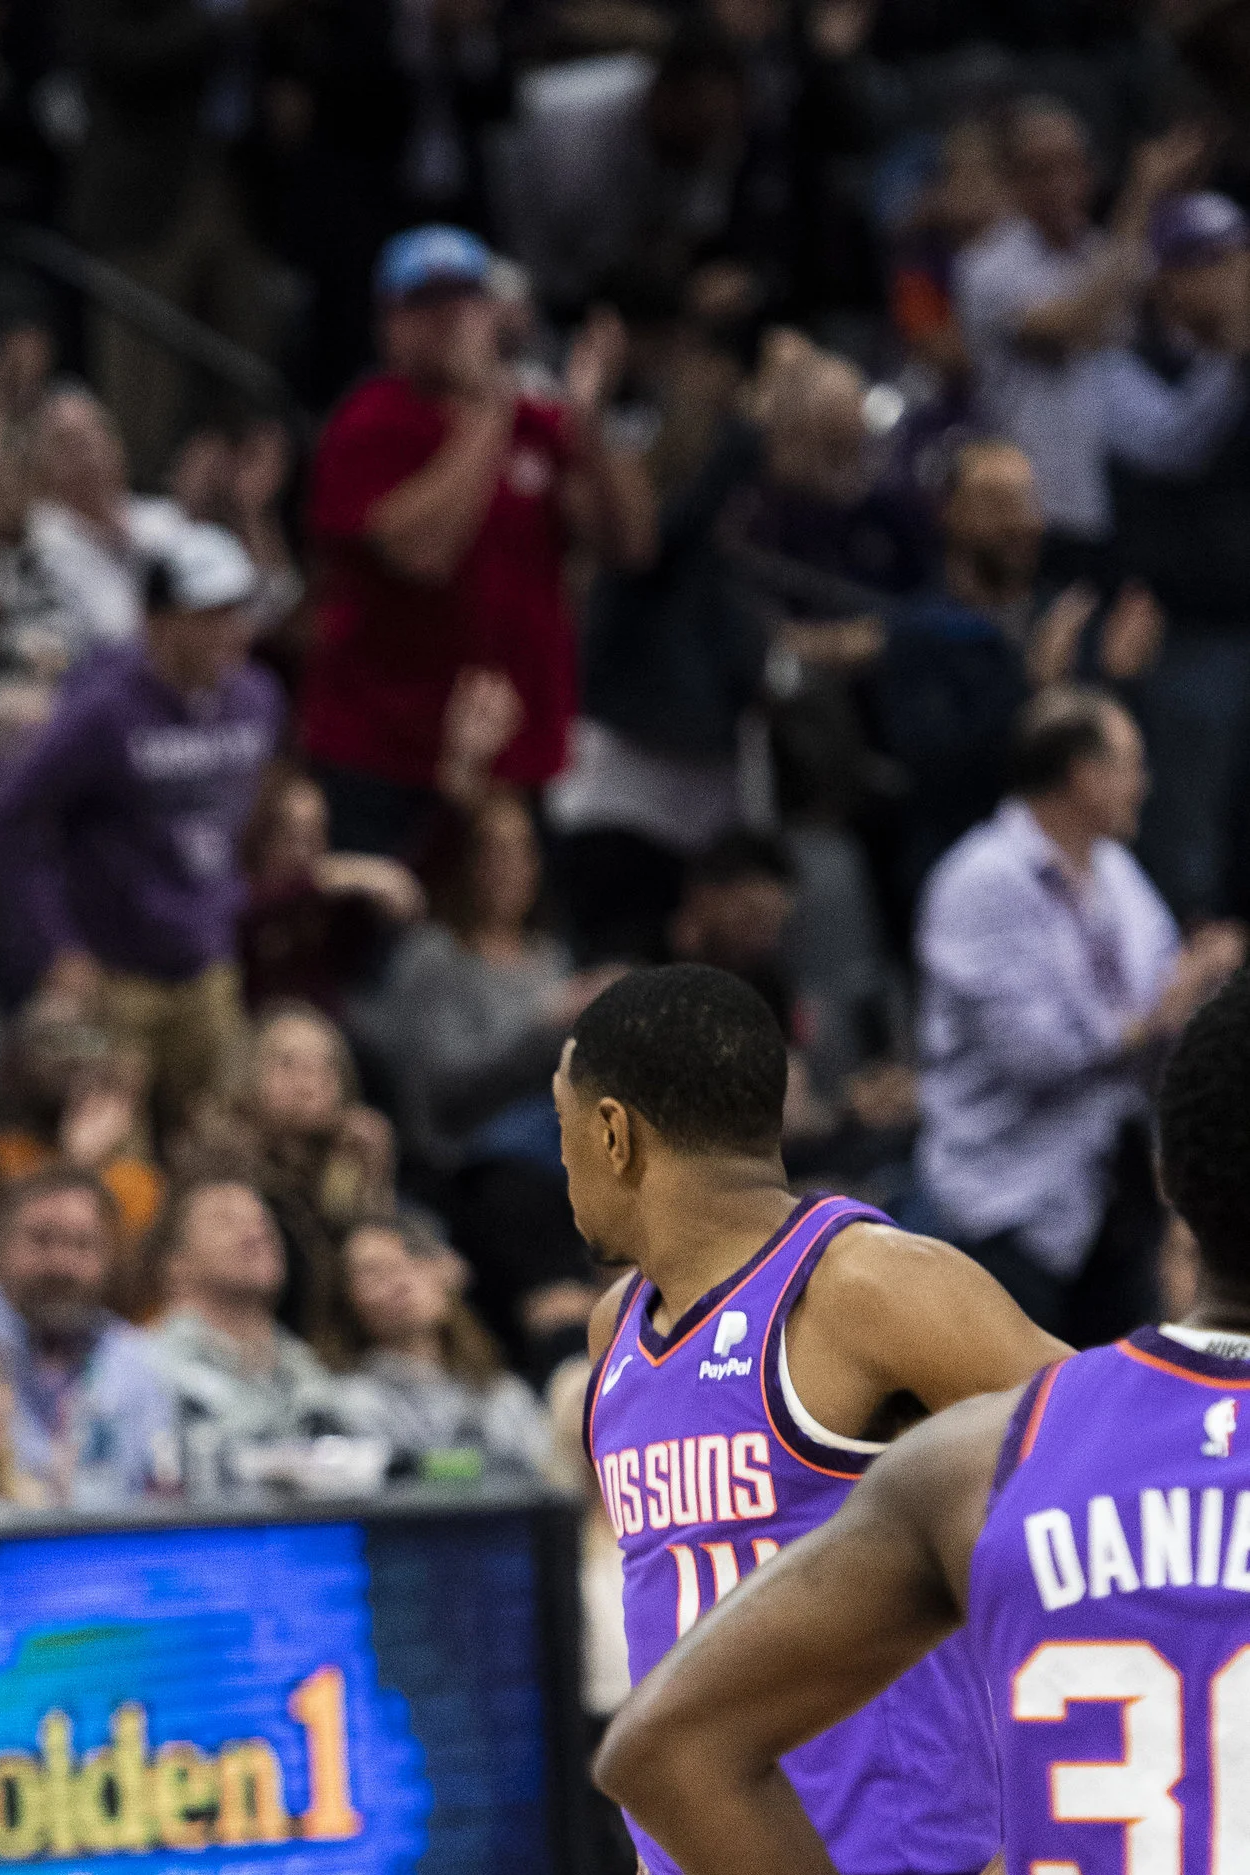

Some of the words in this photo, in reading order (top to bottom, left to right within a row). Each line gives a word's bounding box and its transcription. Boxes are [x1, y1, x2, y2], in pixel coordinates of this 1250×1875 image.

[699, 1356, 753, 1381] PayPal
[593, 1448, 644, 1540] OS
[288, 1664, 363, 1840] 1
